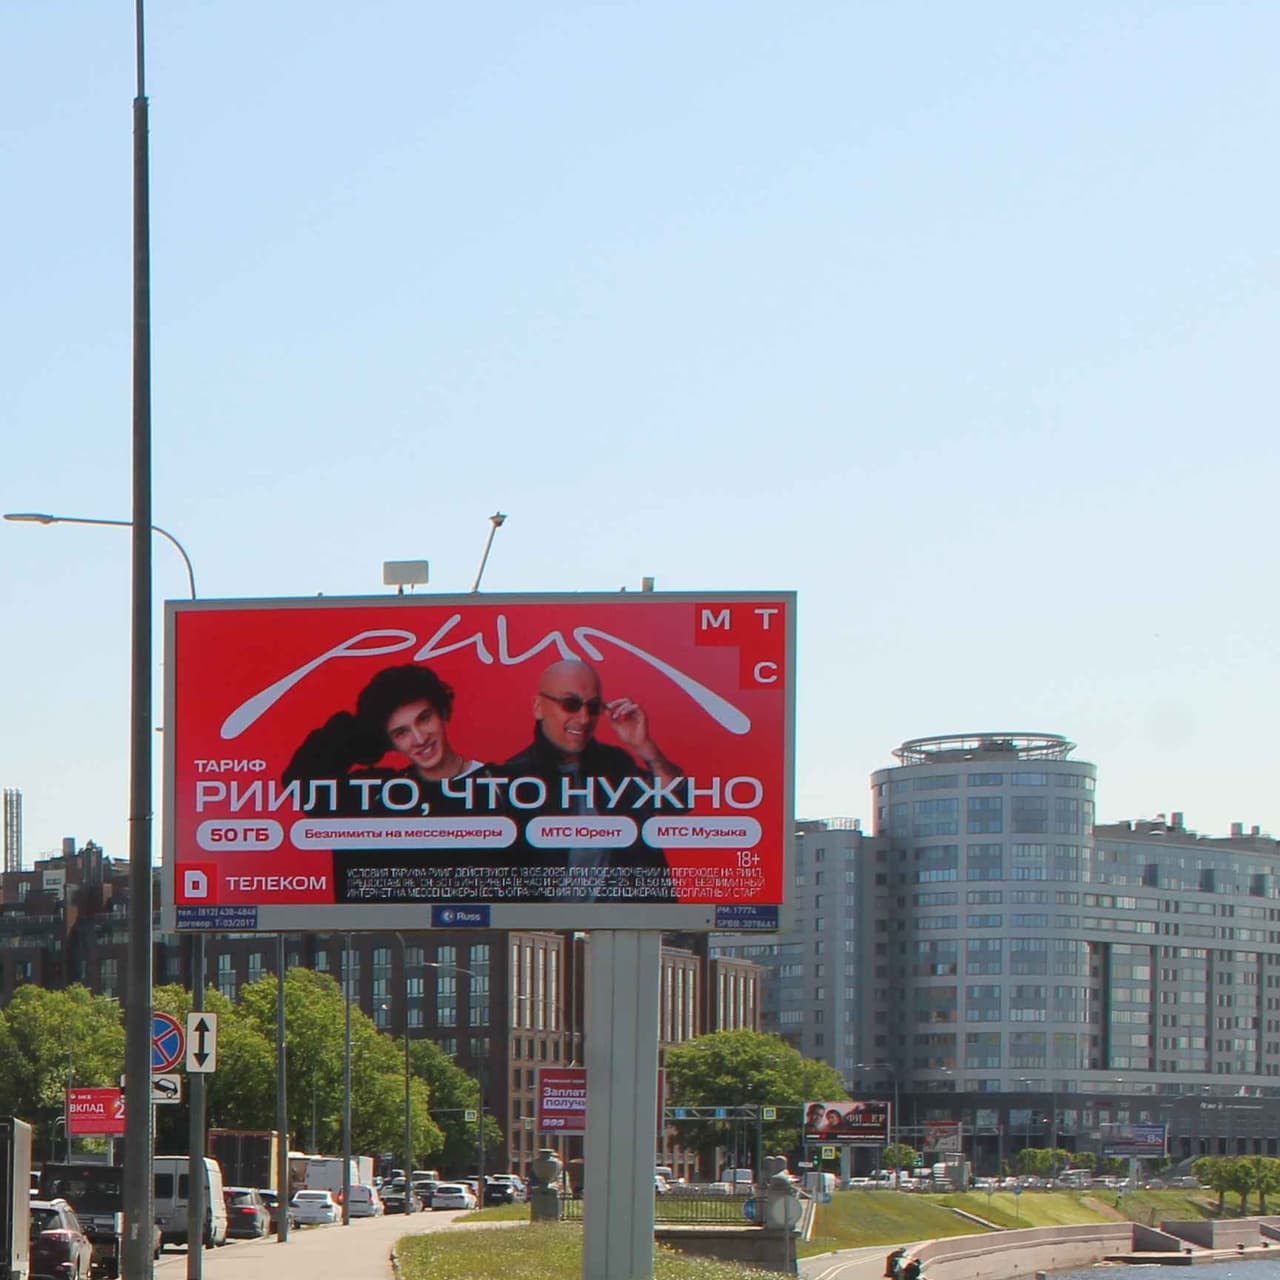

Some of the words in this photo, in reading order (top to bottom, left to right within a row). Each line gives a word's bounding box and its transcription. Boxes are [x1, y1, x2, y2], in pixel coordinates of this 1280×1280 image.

[194, 759, 267, 773] ТАРИФ
[195, 779, 337, 813] РИИЛ
[349, 778, 430, 816] ТО,
[441, 776, 547, 811] ЧТО
[561, 776, 764, 810] НУЖНО
[210, 828, 238, 842] 50
[242, 827, 270, 842] ГБ
[304, 828, 383, 840] Безлимиты
[385, 830, 403, 839] на
[404, 828, 503, 841] мессенджеры
[541, 826, 572, 838] МТС
[574, 826, 623, 841] Юрент
[657, 826, 690, 838] МТС
[691, 826, 747, 840] Музыка
[736, 850, 761, 867] 18+
[225, 876, 327, 890] ТЕЛЕКОМ
[456, 912, 481, 921] Russ
[69, 1103, 104, 1114] ВКЛАД
